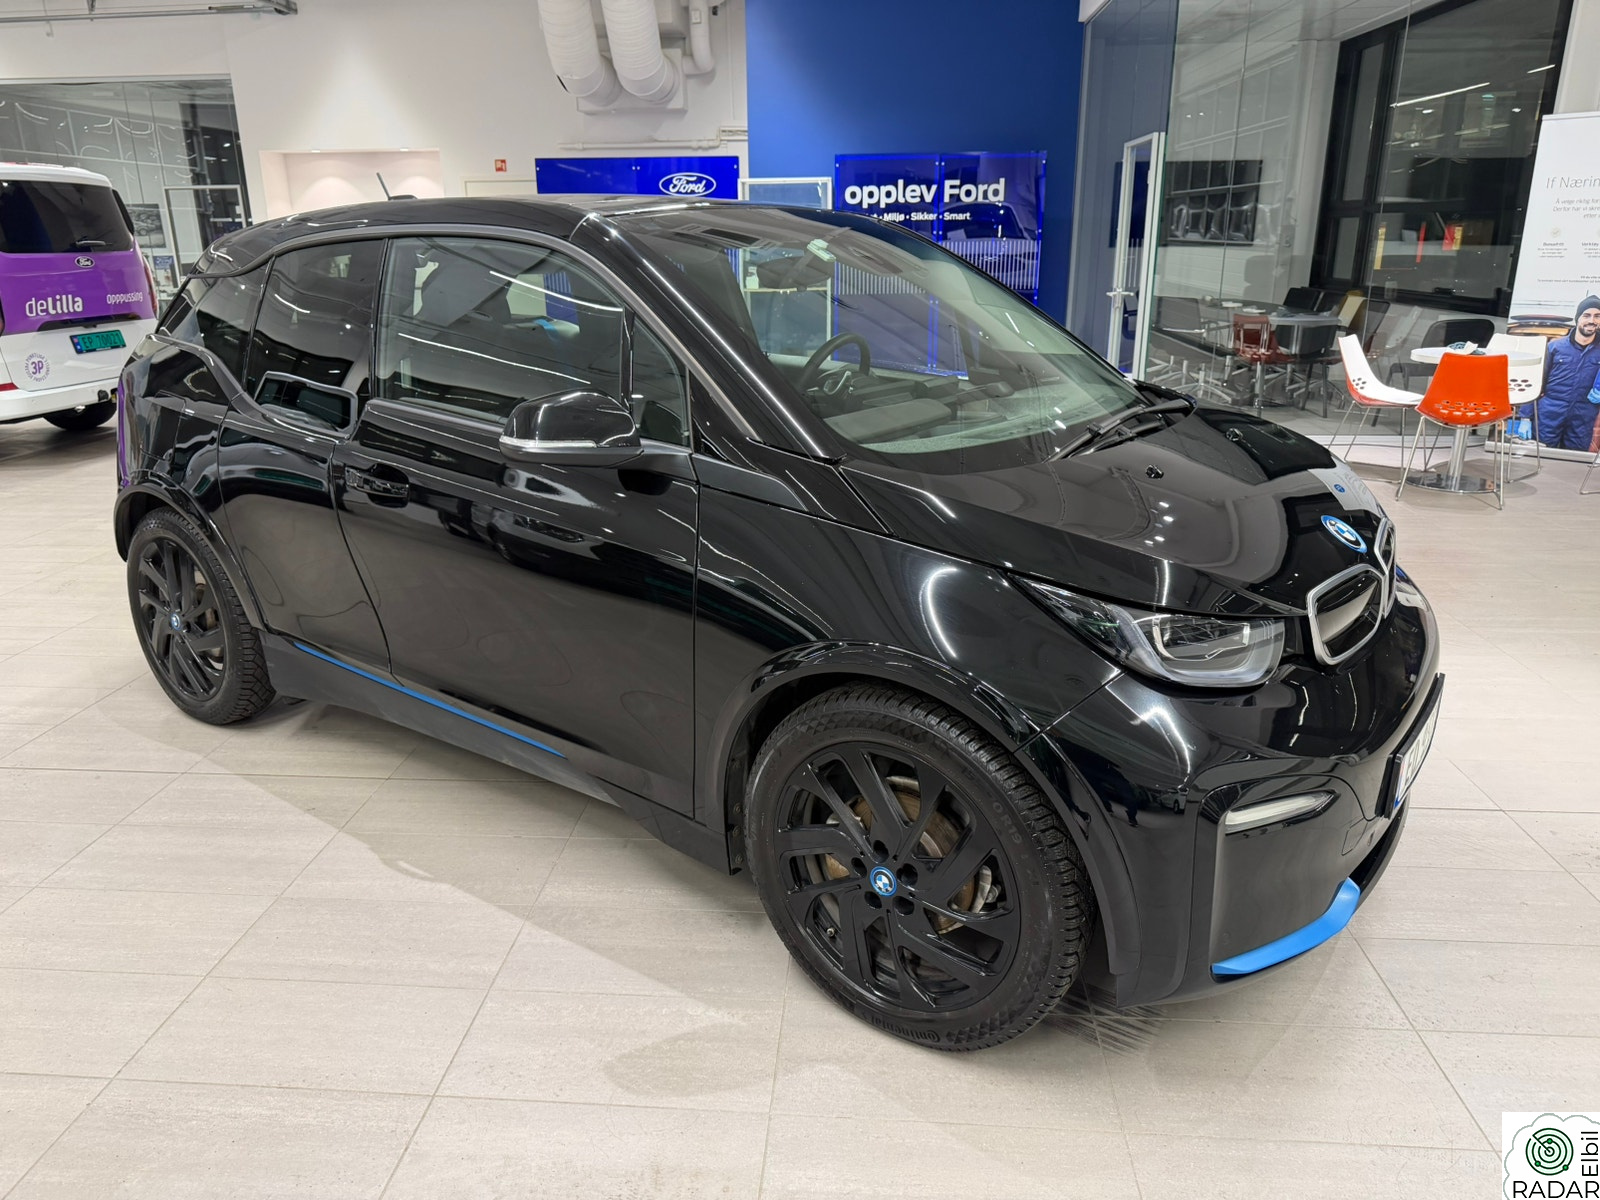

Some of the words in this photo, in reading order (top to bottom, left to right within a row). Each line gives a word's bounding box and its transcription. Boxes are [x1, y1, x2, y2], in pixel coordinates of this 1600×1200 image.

[669, 175, 707, 193] Ford
[1546, 176, 1557, 189] If
[844, 178, 938, 209] opplev
[943, 177, 1005, 203] Ford
[883, 212, 905, 222] Miljø
[910, 212, 937, 221] Sikker
[943, 212, 971, 220] Smart
[30, 360, 44, 375] 3P
